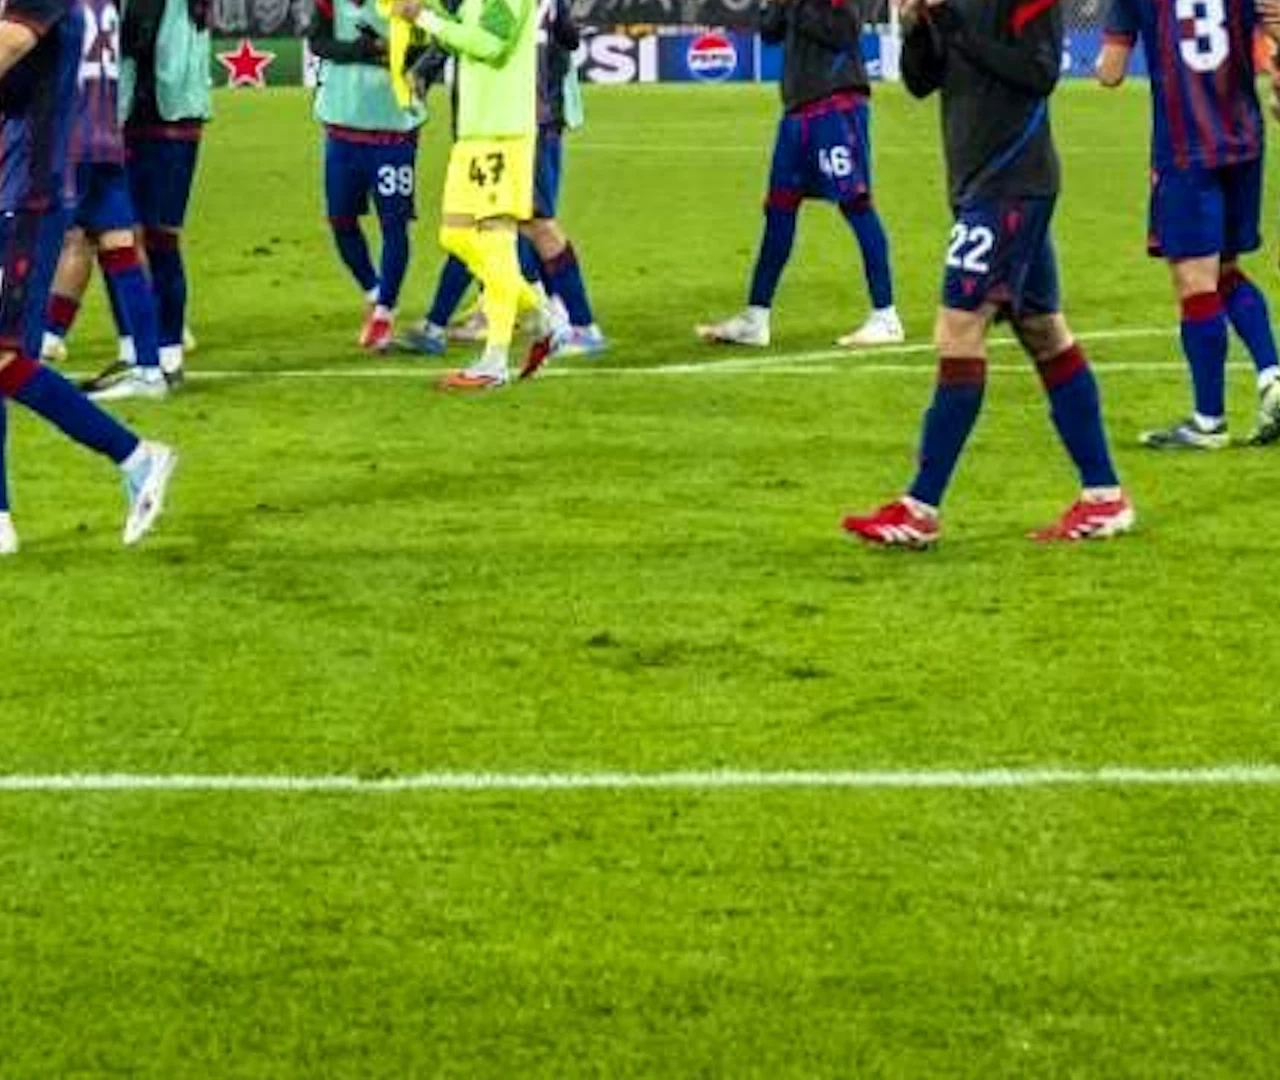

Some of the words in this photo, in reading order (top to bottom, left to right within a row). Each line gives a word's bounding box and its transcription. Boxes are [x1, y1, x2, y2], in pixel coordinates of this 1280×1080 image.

[377, 165, 414, 196] 39
[469, 151, 507, 187] 47
[946, 222, 995, 273] 22
